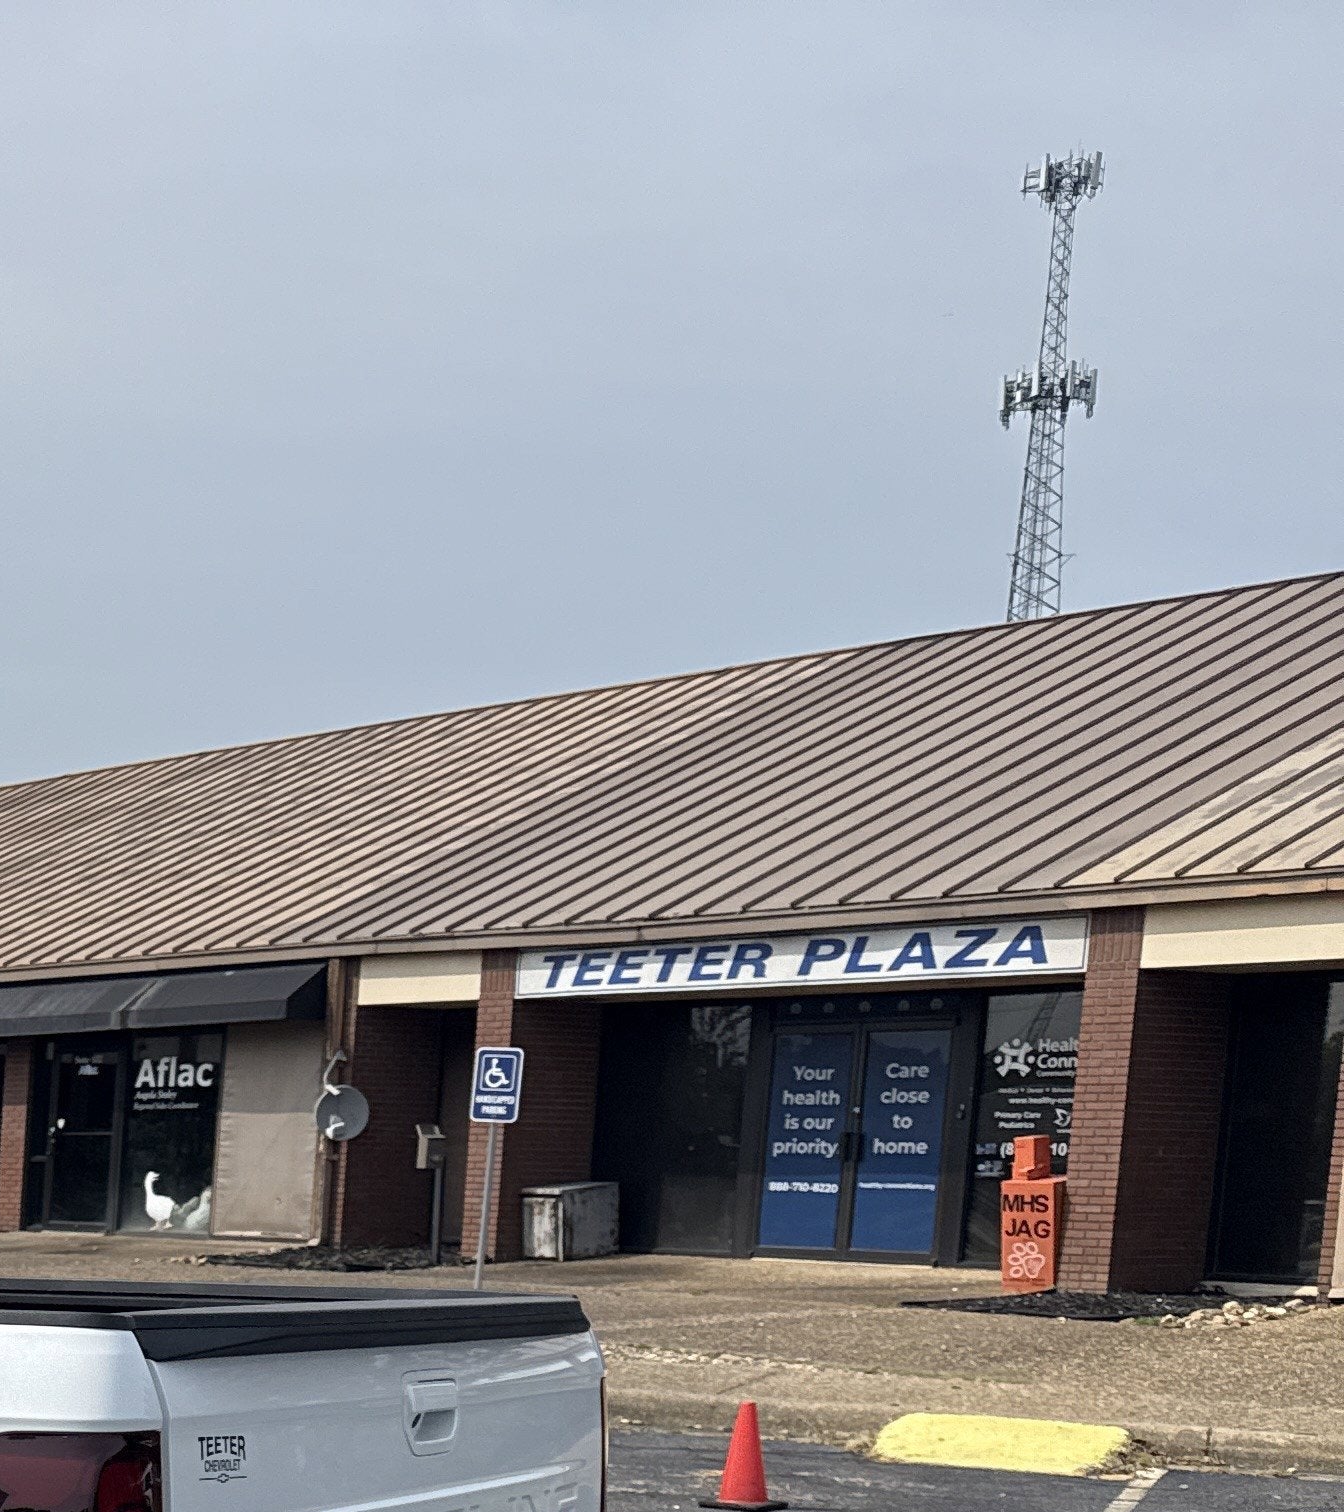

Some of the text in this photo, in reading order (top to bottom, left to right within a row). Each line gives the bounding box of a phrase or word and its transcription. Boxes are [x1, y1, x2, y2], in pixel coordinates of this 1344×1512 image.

[543, 925, 1049, 989] TEETER PLAZA
[134, 1056, 214, 1088] Aflac
[793, 1064, 836, 1081] Your
[885, 1062, 930, 1079] Care
[781, 1089, 841, 1106] health
[879, 1087, 931, 1104] close
[784, 1113, 835, 1131] is our
[891, 1114, 913, 1130] to
[872, 1137, 929, 1155] home
[1002, 1194, 1050, 1213] MHS
[1004, 1219, 1052, 1239] JAG
[198, 1435, 246, 1461] TEETER
